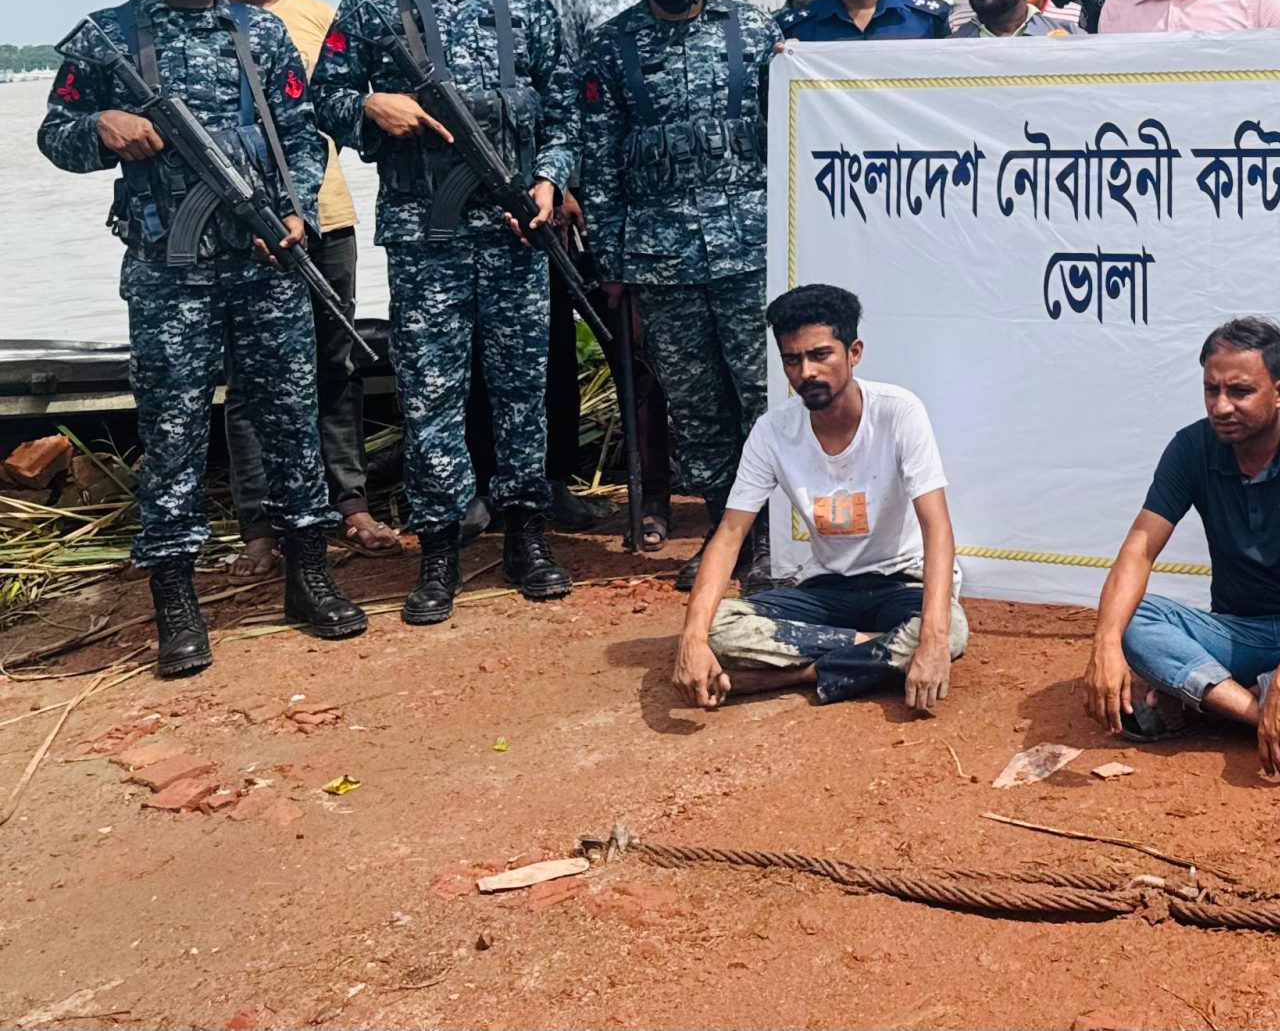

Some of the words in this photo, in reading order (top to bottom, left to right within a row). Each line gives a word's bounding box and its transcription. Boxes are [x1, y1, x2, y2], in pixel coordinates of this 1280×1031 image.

[812, 141, 985, 223] বাংলাদেশ
[996, 118, 1182, 224] নৌবাহিনী
[1043, 244, 1156, 325] ভোলা
